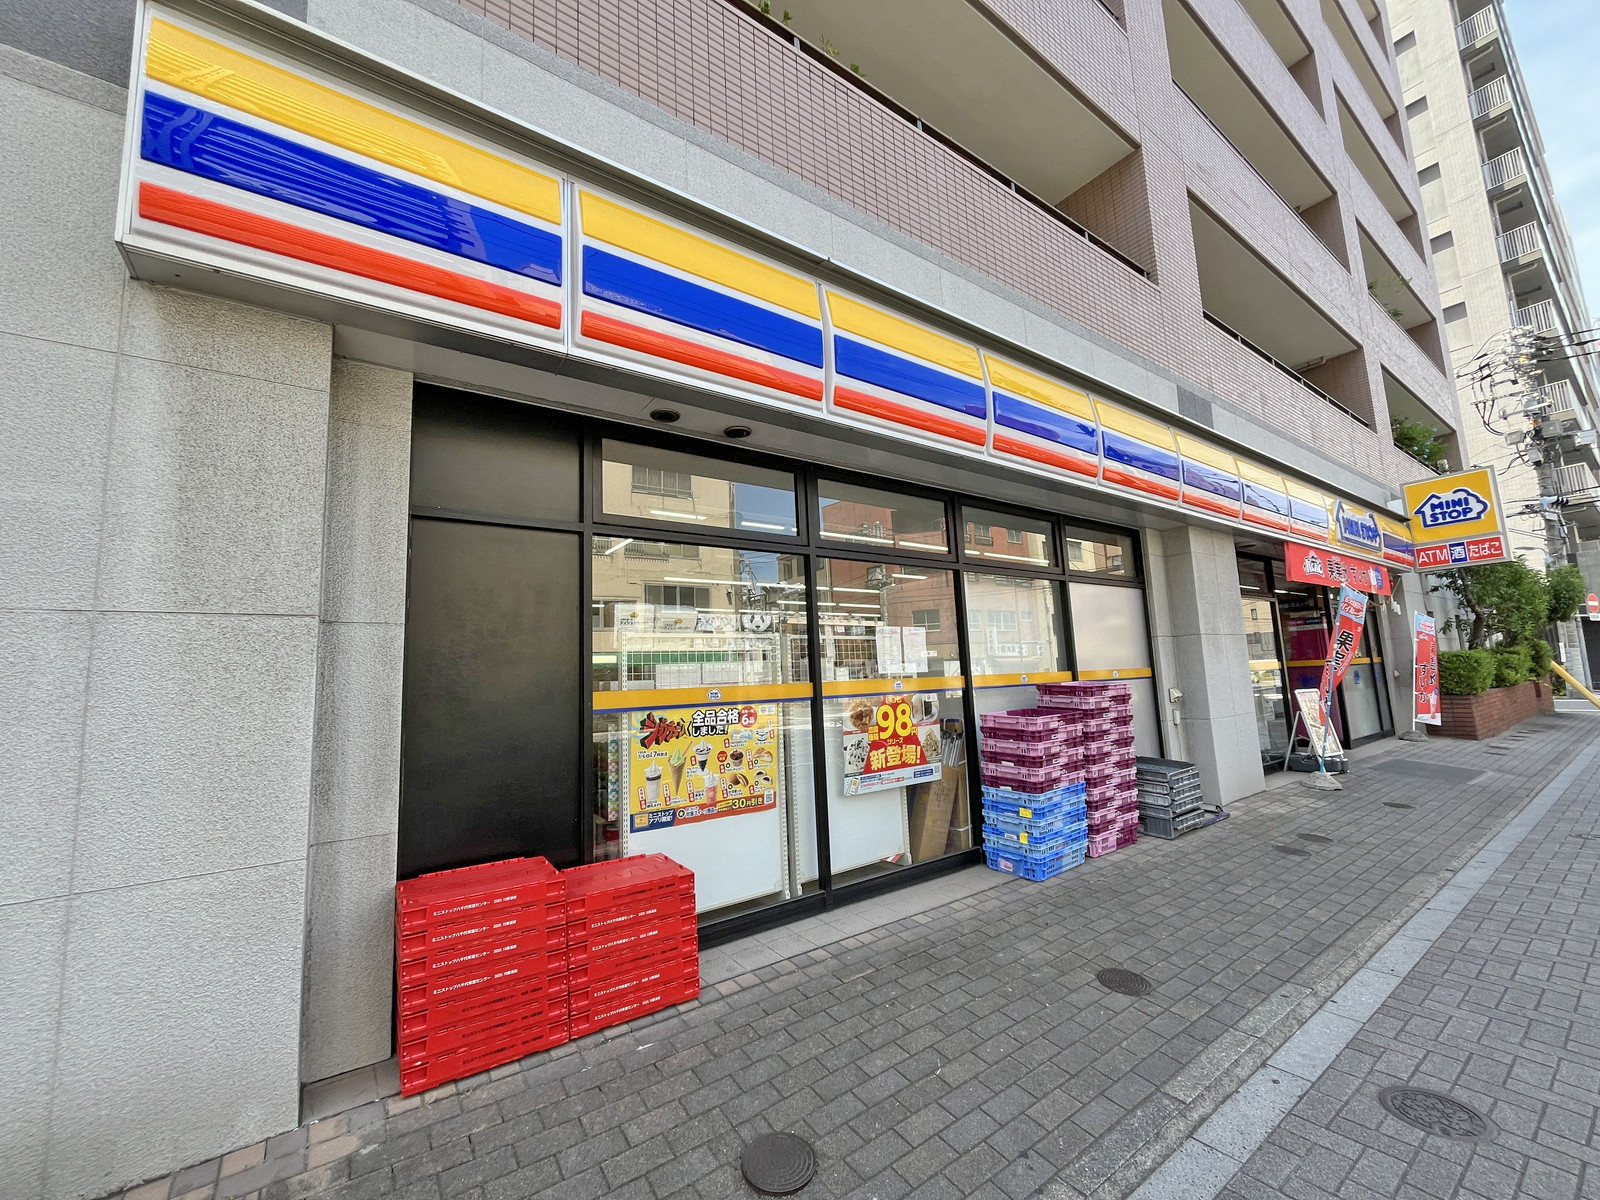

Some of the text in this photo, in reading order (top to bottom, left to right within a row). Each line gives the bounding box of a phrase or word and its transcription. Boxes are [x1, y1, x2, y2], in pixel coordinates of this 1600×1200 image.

[1430, 497, 1469, 512] MINI
[1430, 507, 1473, 522] STOP
[1418, 548, 1449, 563] ATM
[1451, 546, 1465, 559] 酒
[1468, 541, 1502, 557] たばこ
[692, 707, 739, 727] 全品合格
[692, 724, 729, 737] しました!
[869, 744, 921, 771] 新登場!
